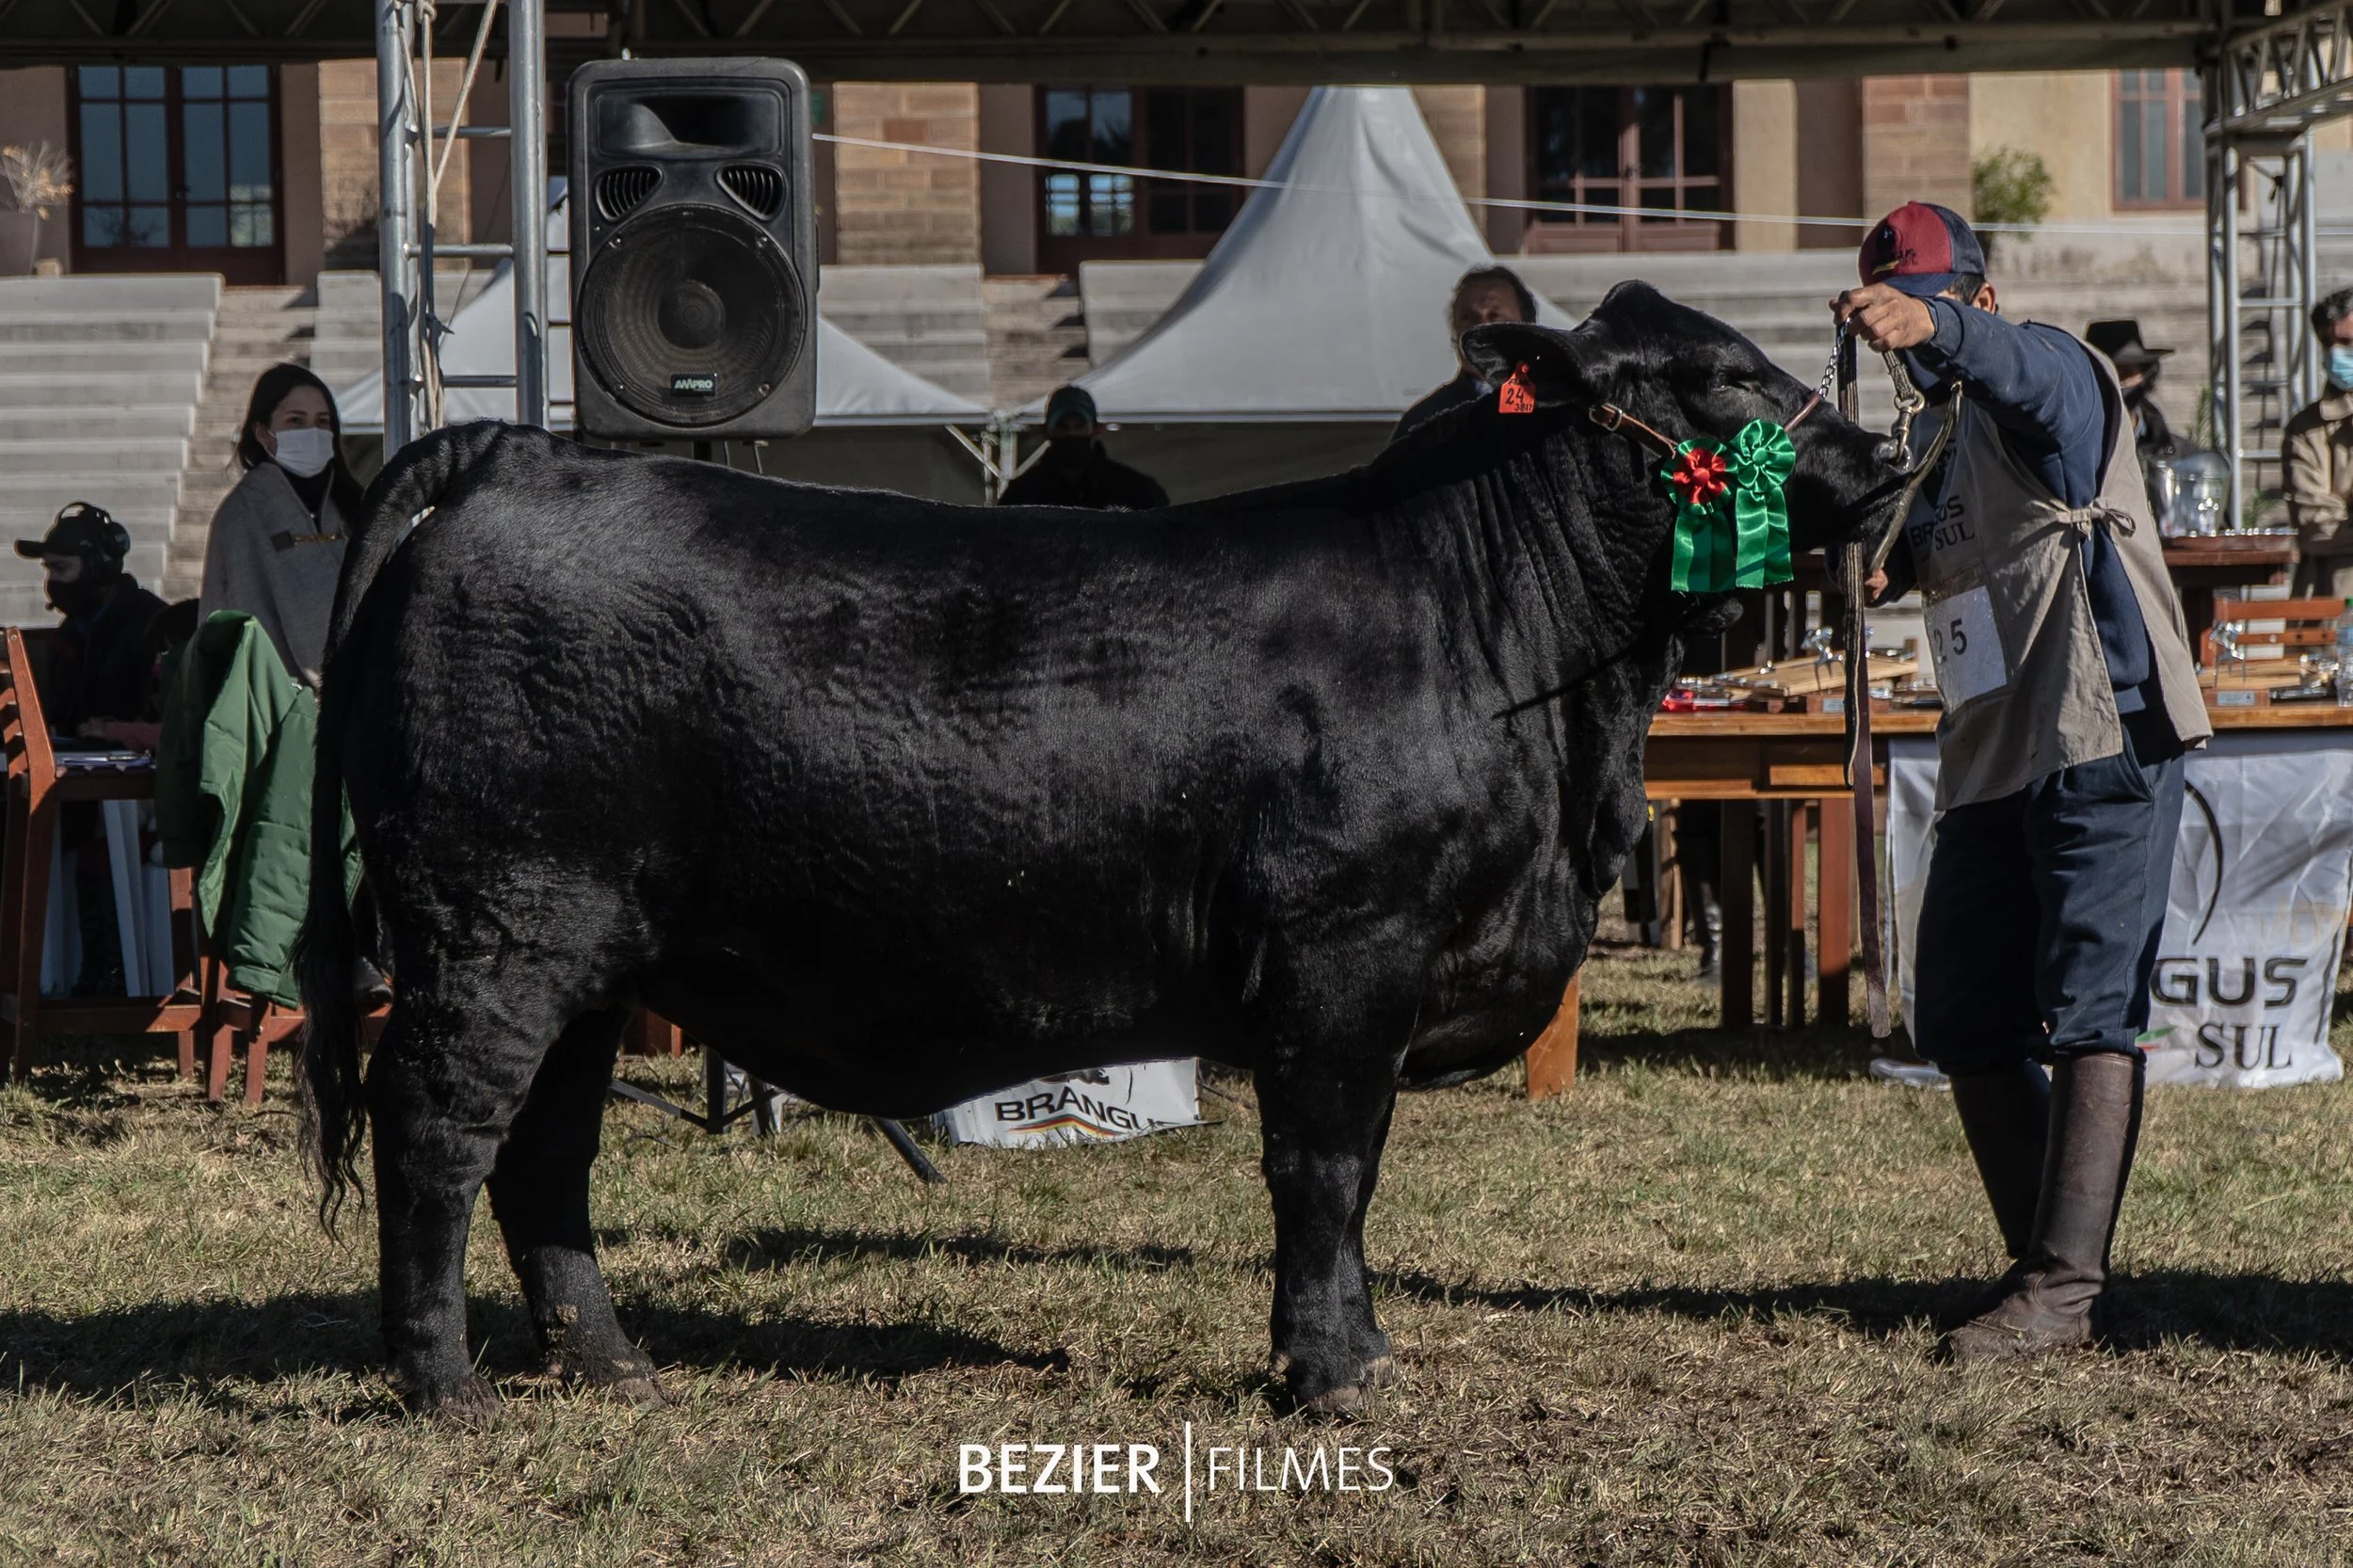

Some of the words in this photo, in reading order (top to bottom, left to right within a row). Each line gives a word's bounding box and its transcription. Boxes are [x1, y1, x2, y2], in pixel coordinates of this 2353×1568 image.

[1506, 387, 1524, 405] 24
[1934, 520, 1975, 551] SUL
[2194, 1023, 2293, 1071] SUL
